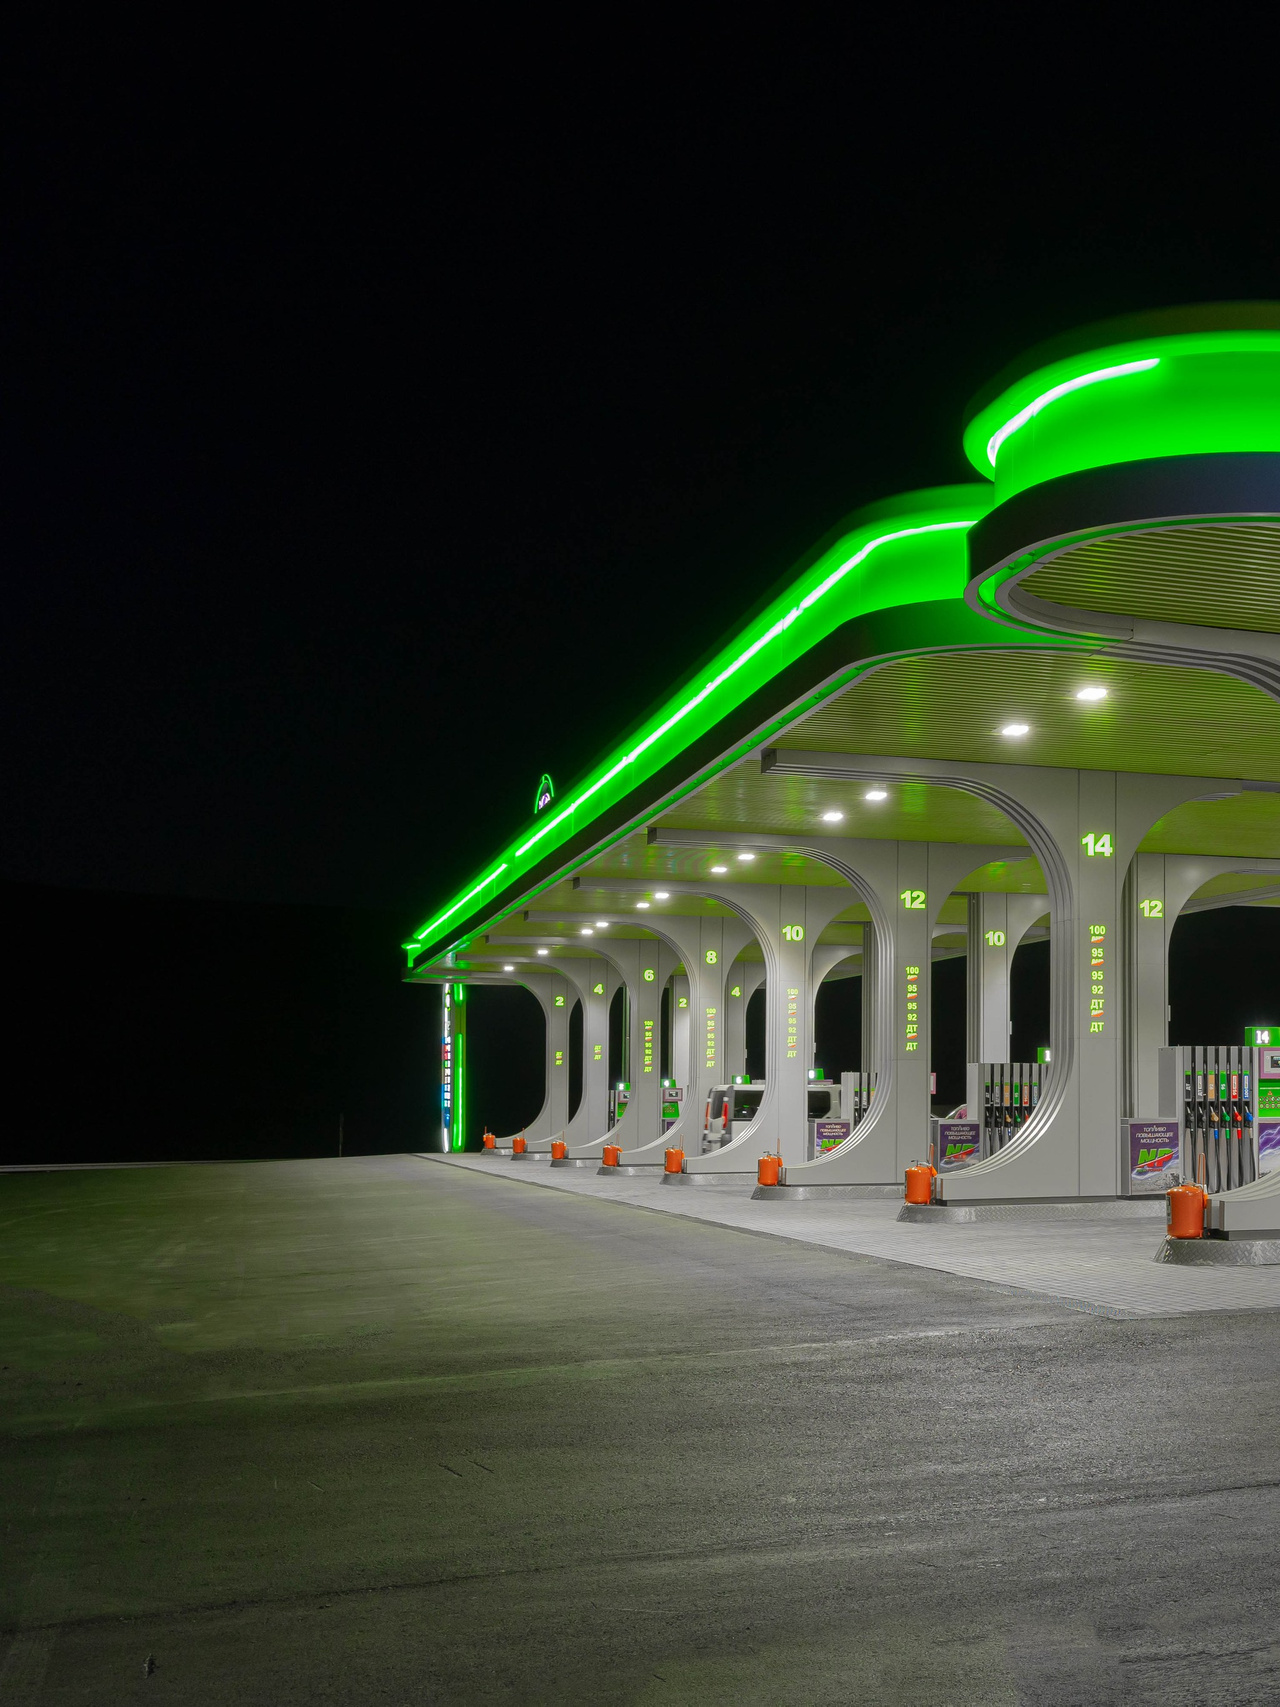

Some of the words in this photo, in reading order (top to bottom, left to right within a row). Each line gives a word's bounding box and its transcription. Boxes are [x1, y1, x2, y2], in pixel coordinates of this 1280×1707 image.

[1081, 833, 1113, 857] 14
[900, 890, 926, 909] 12
[1139, 899, 1163, 918] 12
[782, 925, 804, 941] 10
[1089, 925, 1106, 935] 100
[985, 931, 1006, 946] 10
[705, 950, 717, 964] 8
[1091, 948, 1104, 957] 95
[643, 969, 655, 981] 6
[905, 966, 919, 974] 100
[1091, 971, 1104, 980] 95
[593, 983, 604, 995] 4
[731, 986, 741, 997] 4
[907, 984, 917, 992] 95
[1091, 985, 1104, 994] 92
[555, 996, 564, 1006] 2
[678, 998, 687, 1008] 2
[907, 1002, 917, 1010] 95
[1090, 999, 1104, 1010] ДТ
[907, 1013, 917, 1021] 92
[906, 1024, 918, 1033] ДТ
[1090, 1022, 1104, 1033] ДТ
[1255, 1030, 1269, 1044] 14
[906, 1042, 918, 1051] ДТ
[787, 1050, 797, 1058] ДТ
[944, 1143, 976, 1159] NP
[1136, 1148, 1175, 1168] NP
